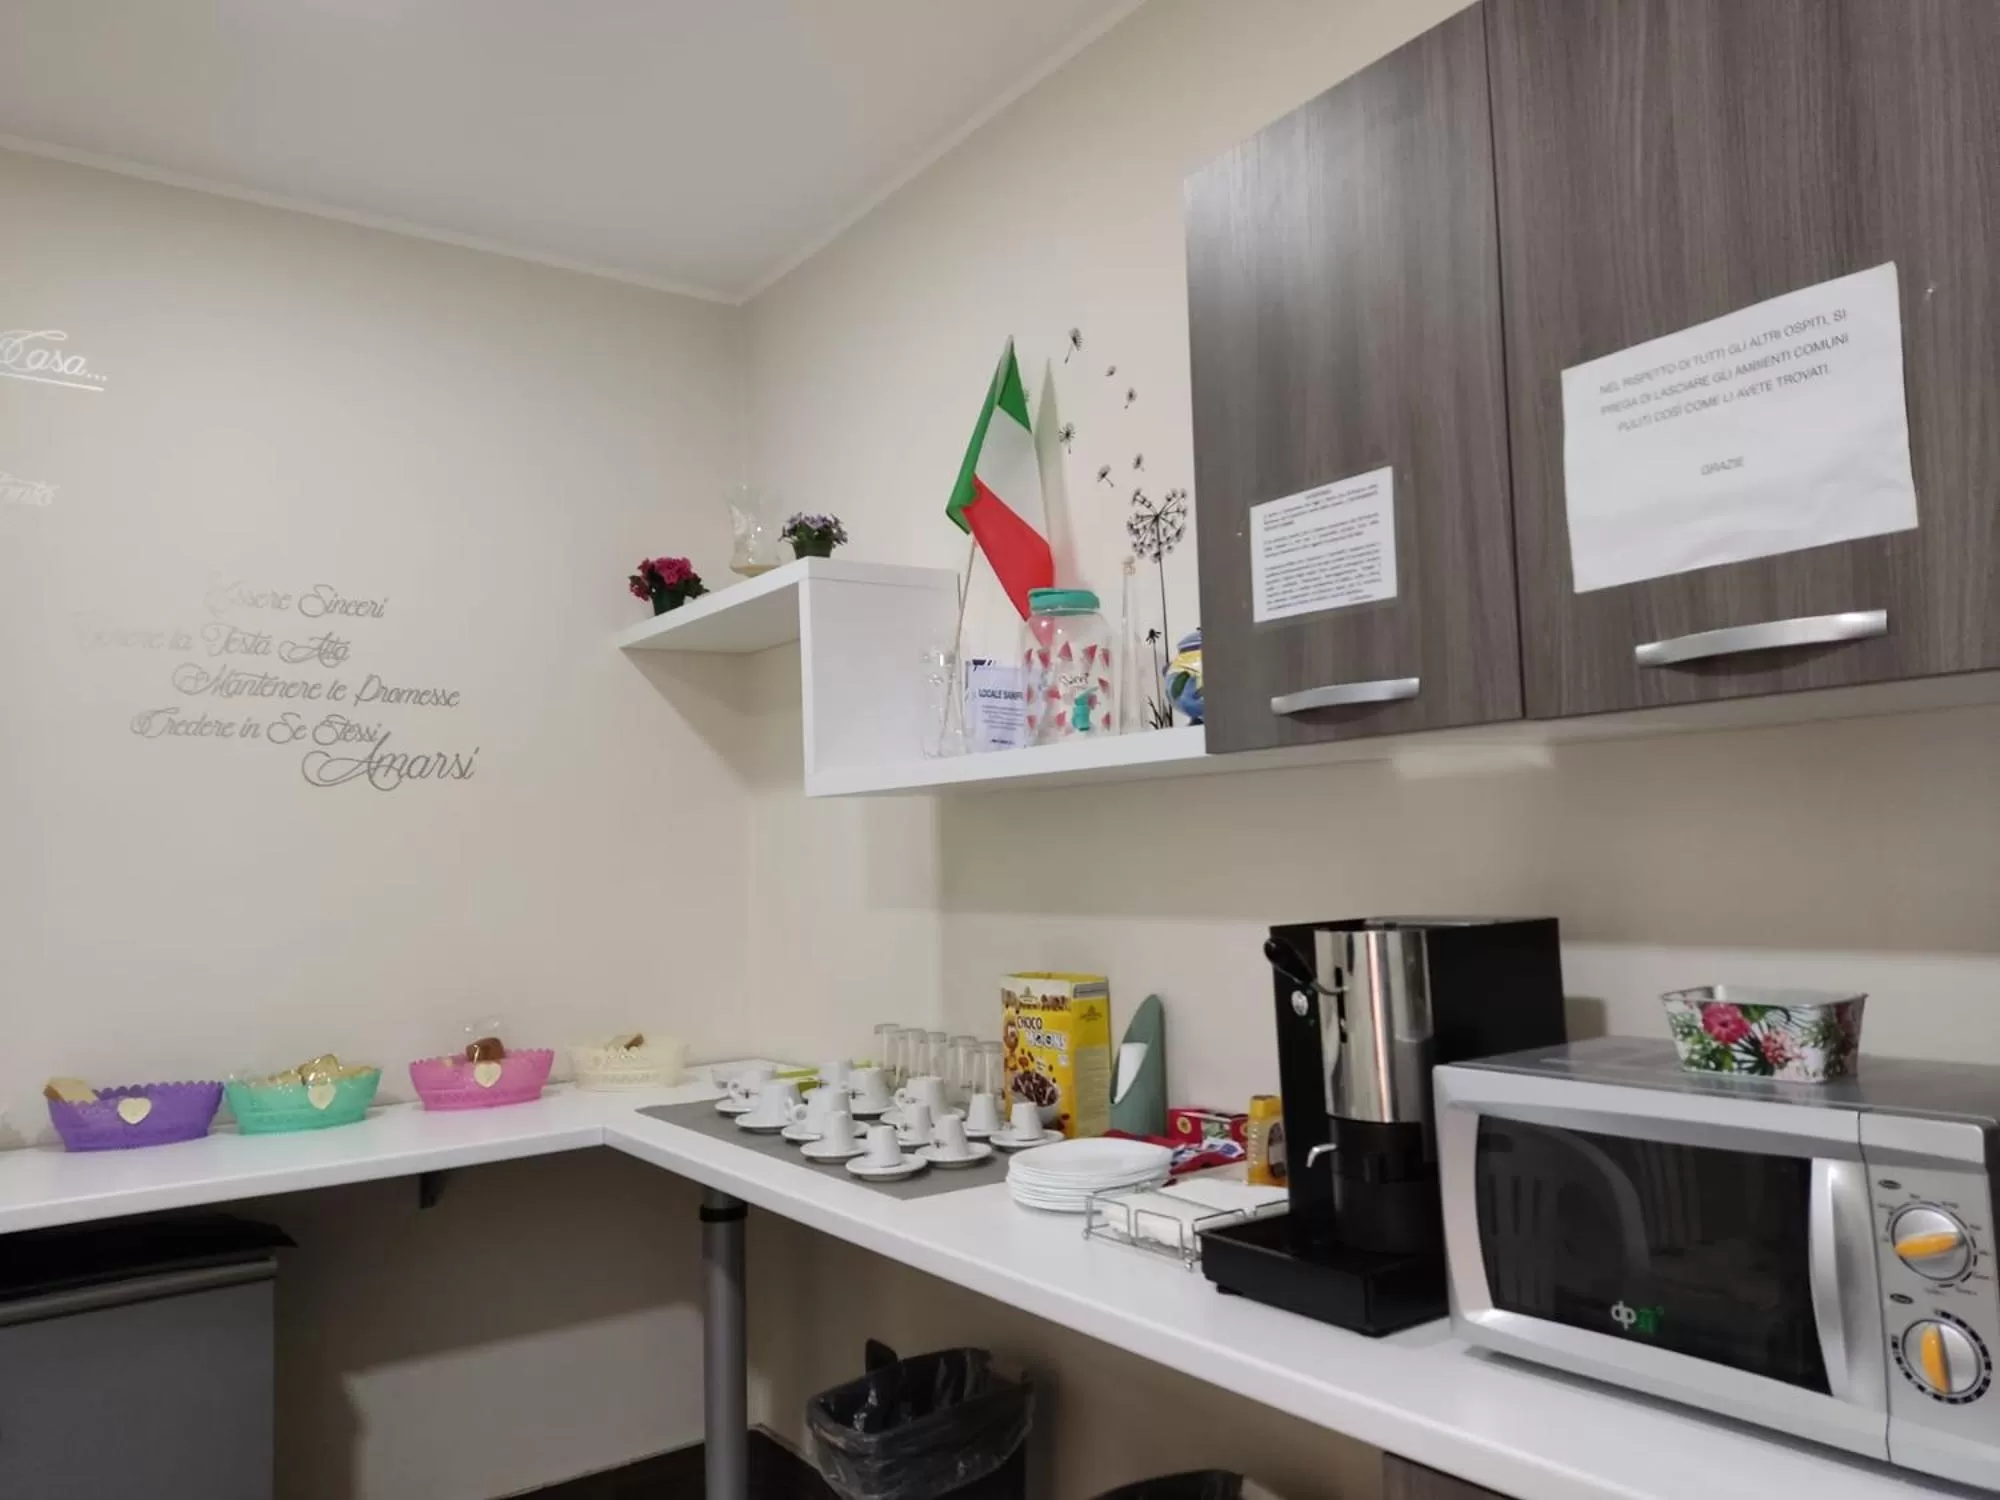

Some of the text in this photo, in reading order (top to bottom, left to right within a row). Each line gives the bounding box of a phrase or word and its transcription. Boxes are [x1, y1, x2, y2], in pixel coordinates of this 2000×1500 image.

[1599, 378, 1621, 395] NEL
[1622, 363, 1676, 388] RISPETTO
[1692, 346, 1726, 366] TUTTI
[1727, 341, 1747, 356] GLI
[1749, 328, 1782, 349] ALTRI
[1832, 307, 1848, 323] SI
[1600, 396, 1638, 416] PREGA
[1653, 372, 1711, 401] LASCIARE
[1712, 368, 1733, 384] GLI
[1735, 350, 1792, 376] AMBIENTI
[1793, 331, 1849, 359] COMUNI
[1617, 413, 1653, 432] PULITI
[1684, 393, 1720, 414] COME
[1722, 390, 1735, 404] LI
[1736, 378, 1773, 400] AVETE
[1700, 455, 1745, 476] GRAZIE
[298, 583, 390, 618] Sinceri
[201, 621, 273, 657] Testa
[278, 631, 352, 668] Alta
[172, 662, 461, 708] Mantenere le Promesse
[978, 688, 1002, 699] LOCALE
[130, 707, 384, 746] Credere in Se Stessi
[302, 730, 480, 791] Amarsi
[1016, 1015, 1043, 1030] CHOCO
